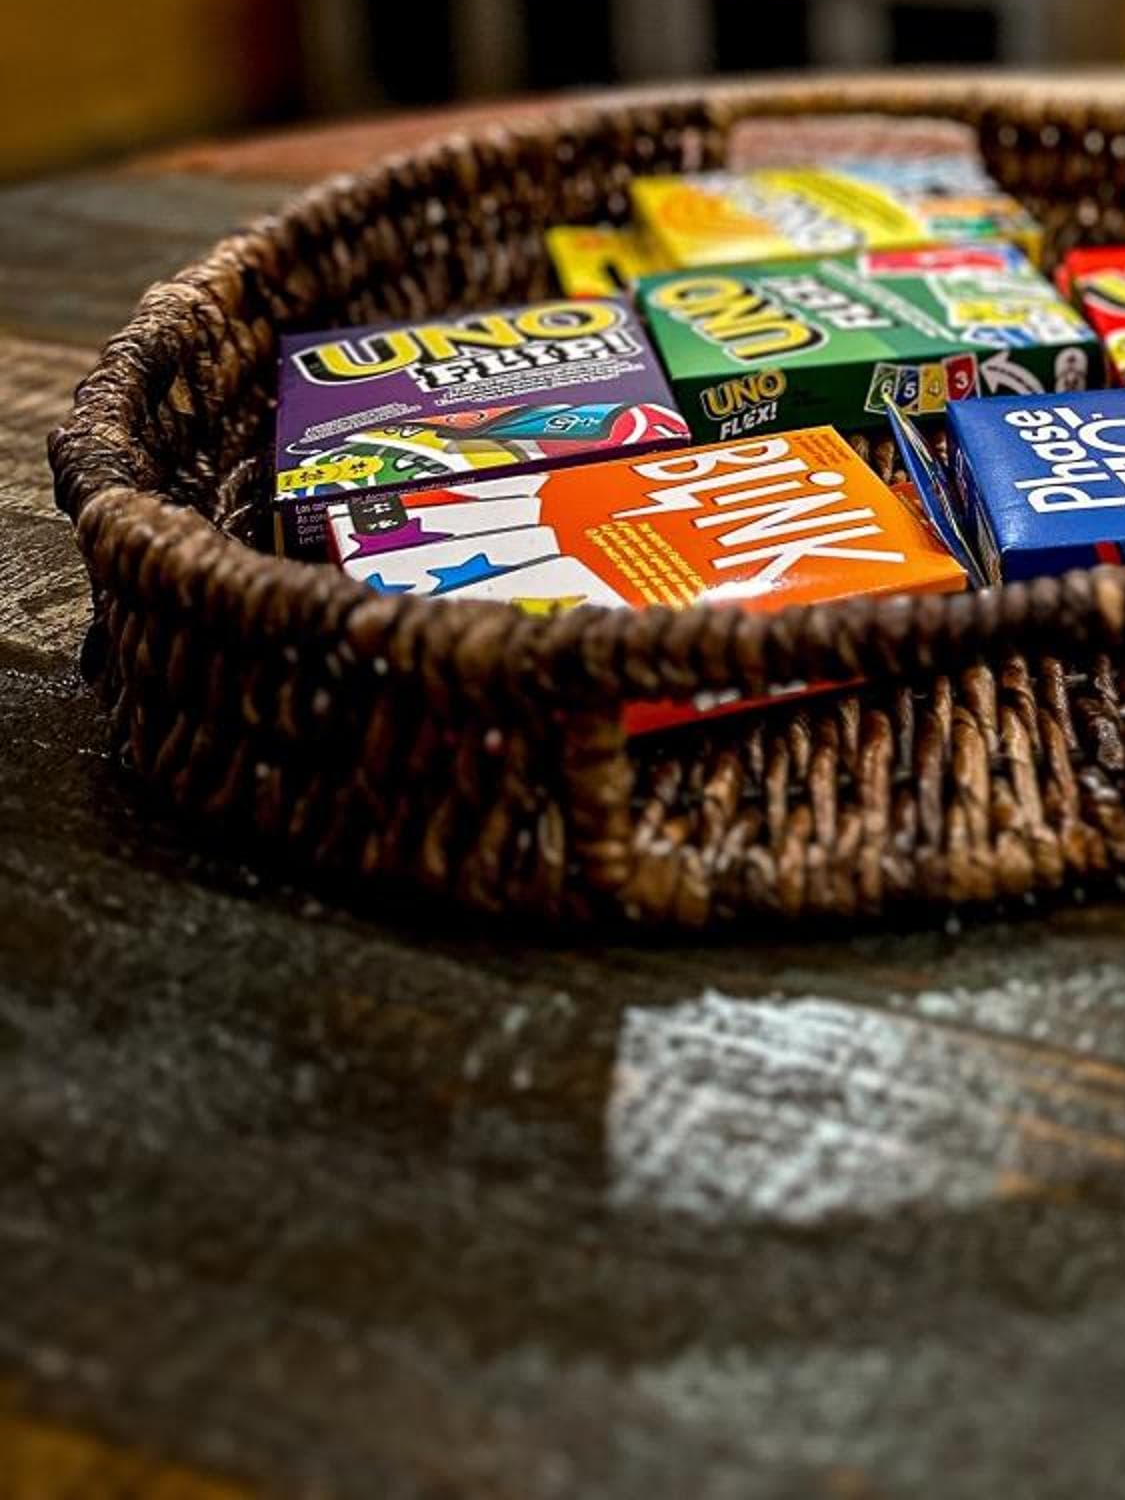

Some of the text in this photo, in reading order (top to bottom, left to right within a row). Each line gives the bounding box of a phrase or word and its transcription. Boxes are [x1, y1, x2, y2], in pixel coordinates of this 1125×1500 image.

[296, 301, 622, 380] UNO
[652, 277, 822, 363] UNO
[422, 328, 641, 388] FLIP!
[903, 382, 917, 399] 5
[955, 371, 969, 389] 3
[703, 367, 786, 418] UNO
[719, 402, 777, 440] FLEX!
